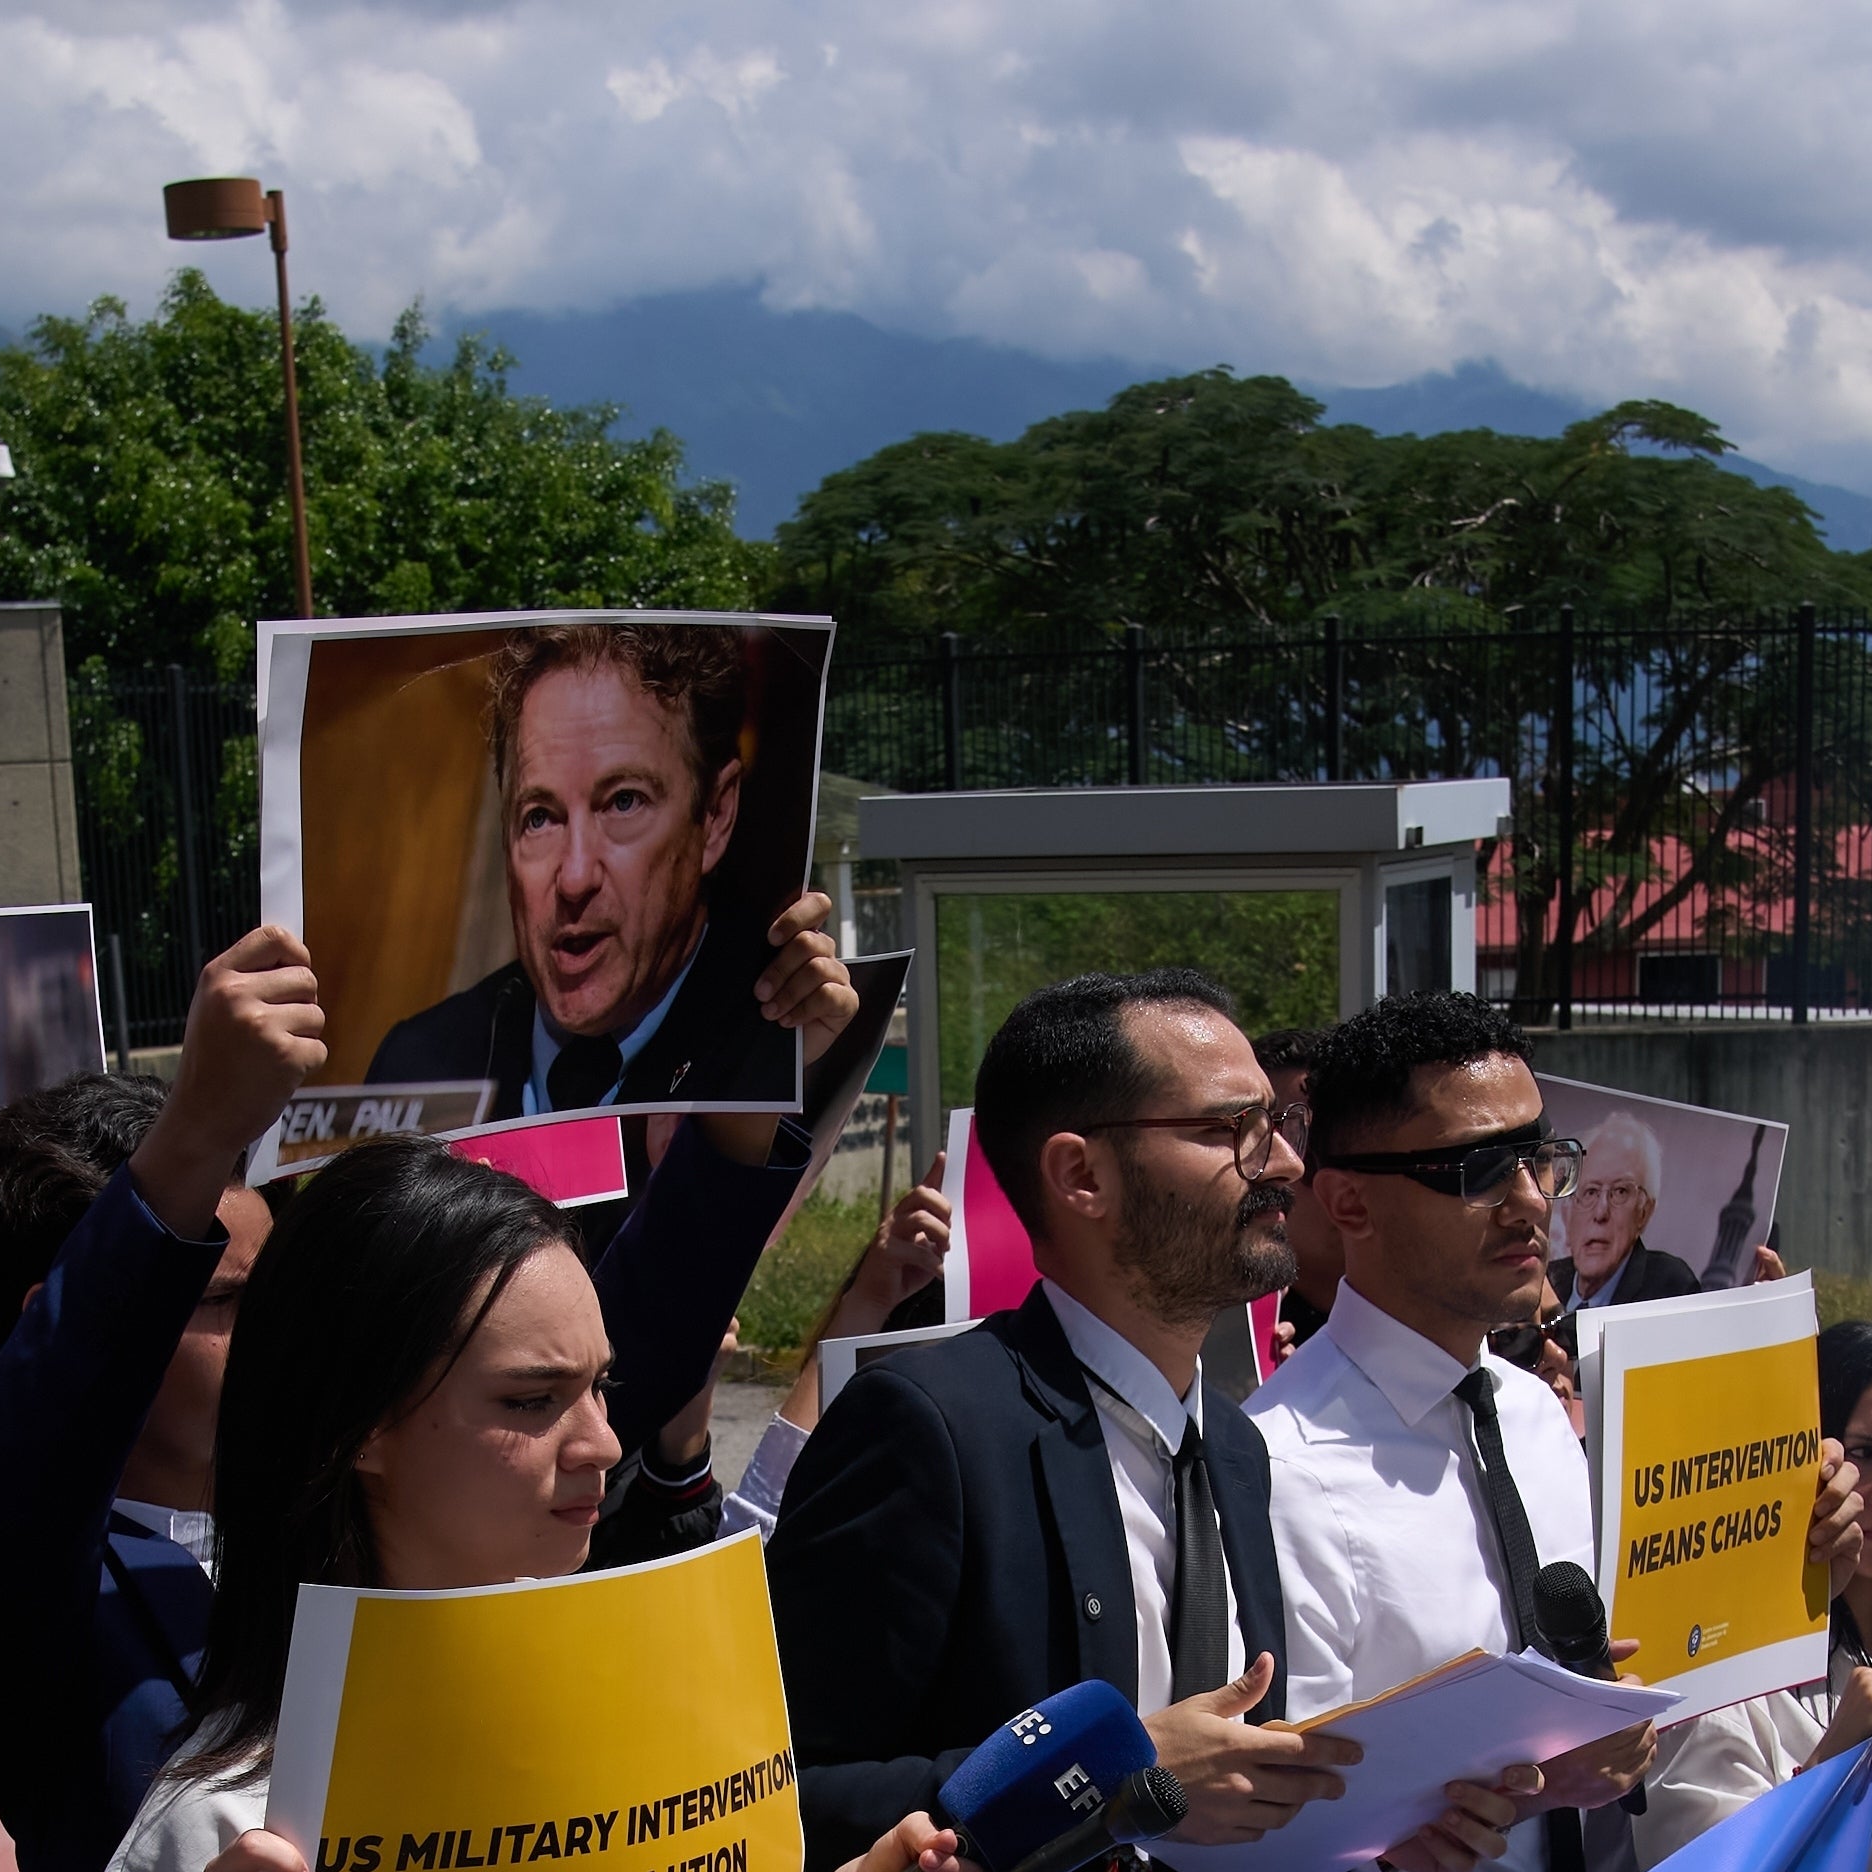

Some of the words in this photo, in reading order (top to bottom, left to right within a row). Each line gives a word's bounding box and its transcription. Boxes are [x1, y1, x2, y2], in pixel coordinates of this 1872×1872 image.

[1634, 1463, 1664, 1508] US
[1669, 1427, 1819, 1499] INTERVENTION
[1628, 1522, 1705, 1579] MEANS
[1711, 1500, 1782, 1554] CHAOS
[395, 1809, 618, 1872] MILITARY
[627, 1747, 794, 1846] INTERVENTION
